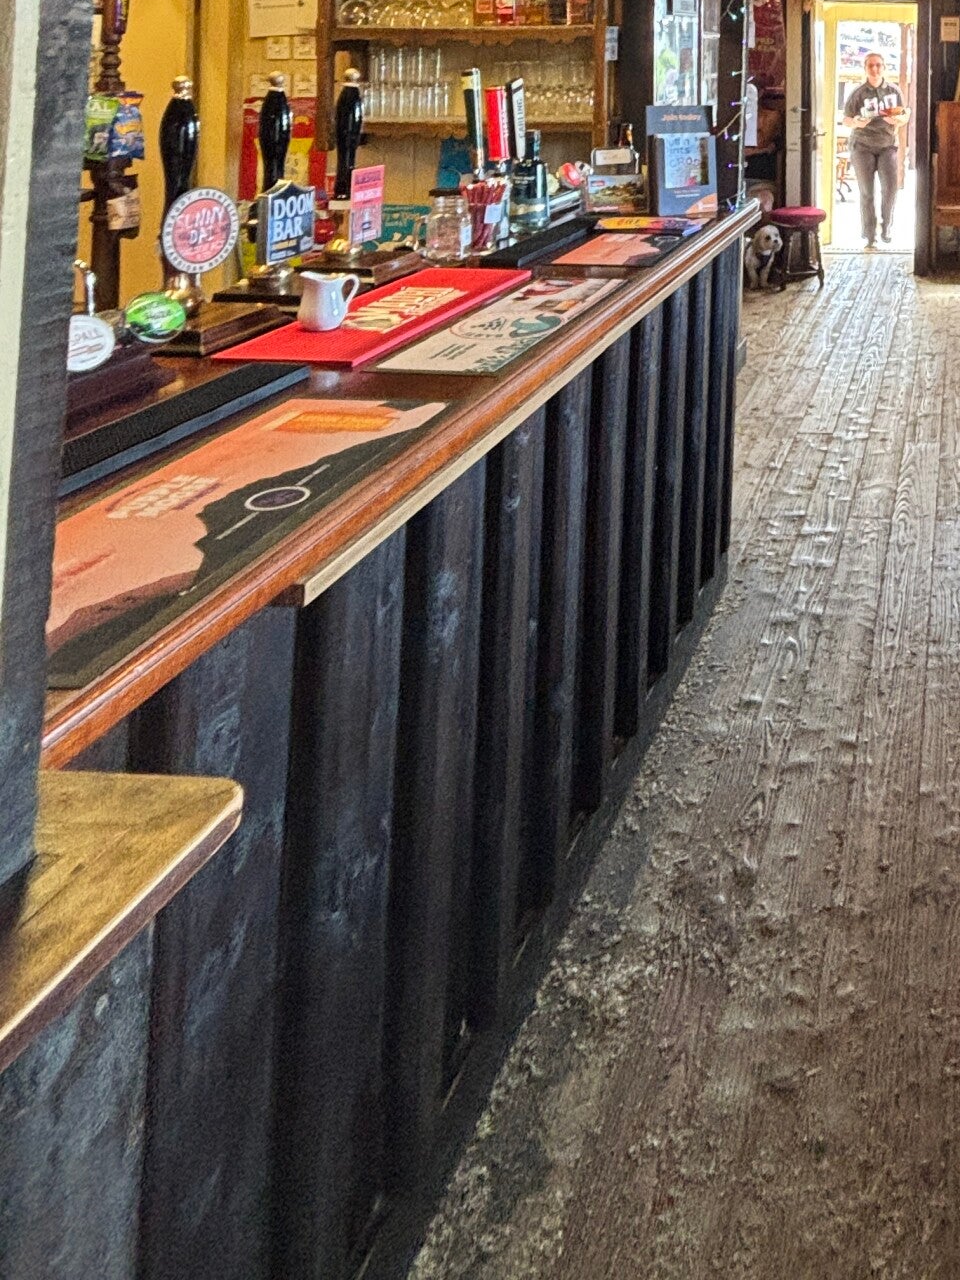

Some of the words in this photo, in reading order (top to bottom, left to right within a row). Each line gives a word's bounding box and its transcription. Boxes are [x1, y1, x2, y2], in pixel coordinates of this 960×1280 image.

[515, 98, 526, 140] CARLING
[272, 192, 315, 221] DOOM
[272, 216, 304, 243] BAR
